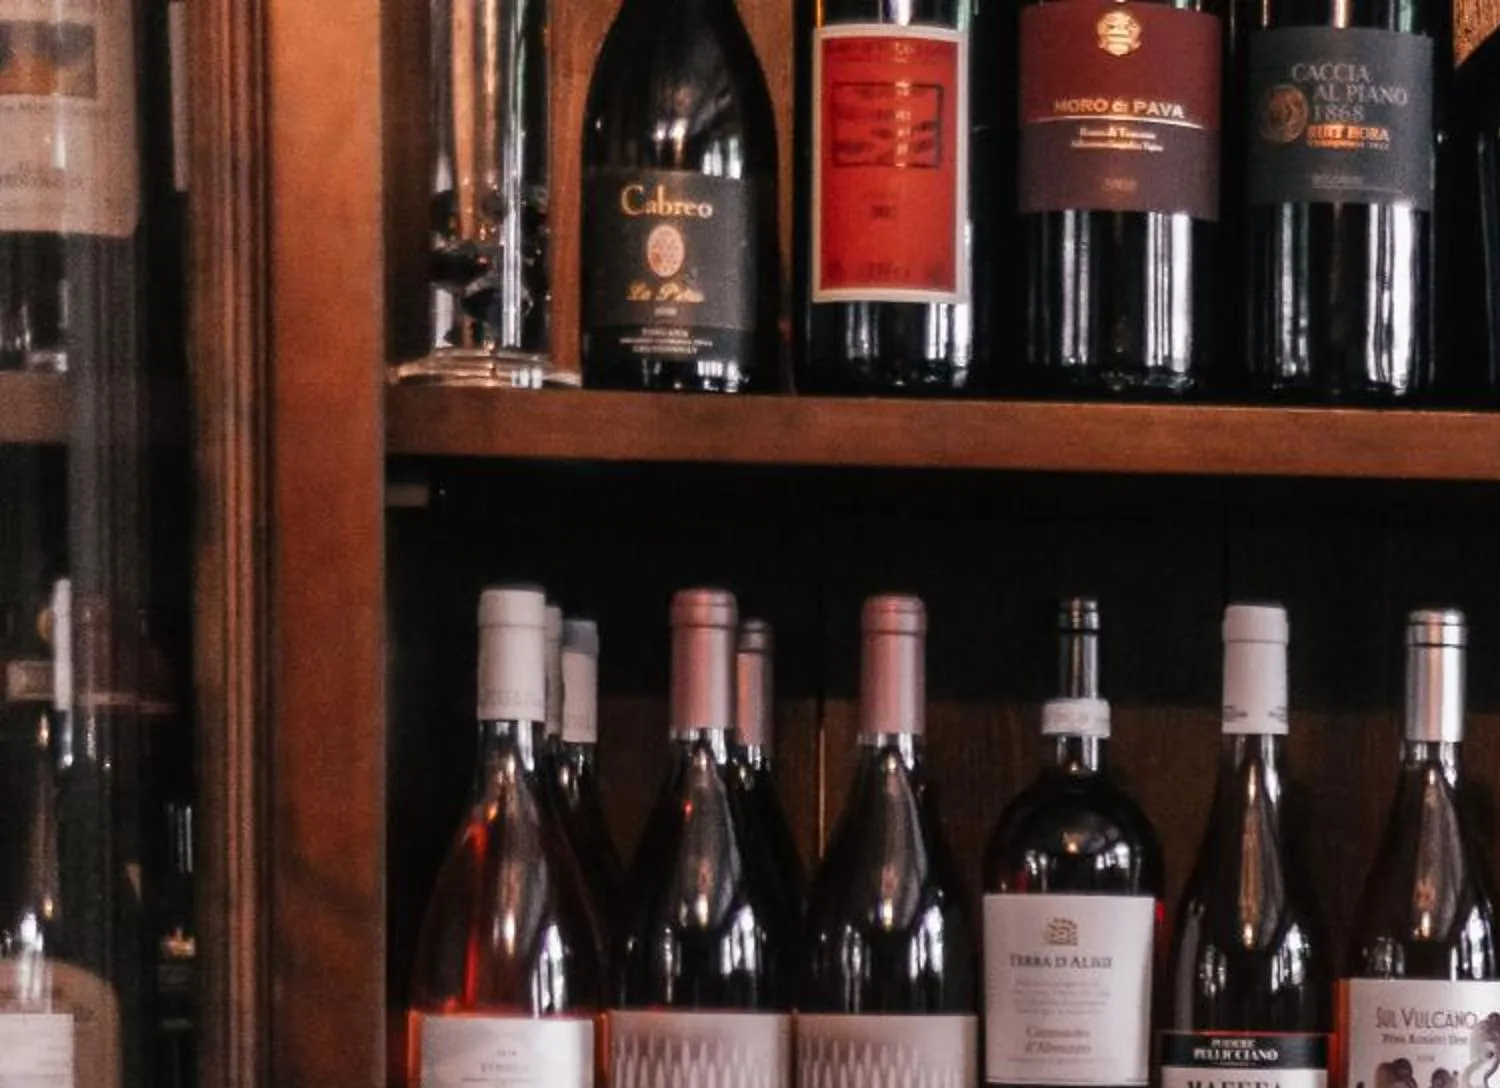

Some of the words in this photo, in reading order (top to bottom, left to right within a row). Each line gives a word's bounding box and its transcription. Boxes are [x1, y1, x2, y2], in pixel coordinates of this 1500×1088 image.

[1291, 63, 1370, 82] CACCIA
[1313, 83, 1341, 101] AL
[1346, 84, 1408, 106] PIANO
[1054, 98, 1109, 113] MORO
[1133, 101, 1184, 118] PAVA
[620, 184, 713, 218] Cabreo
